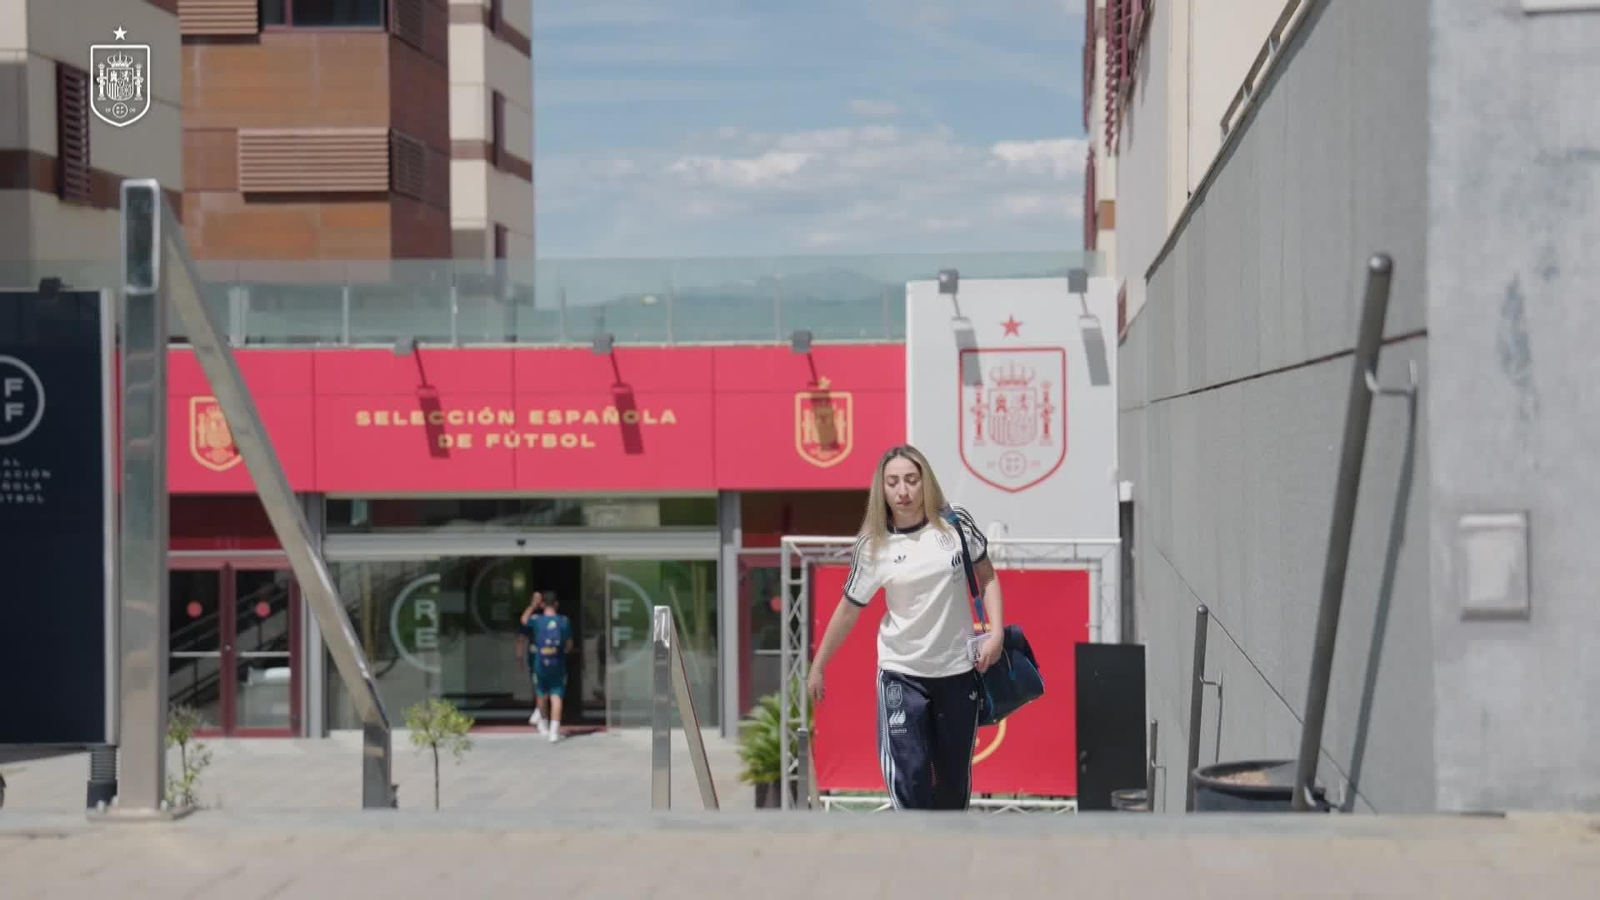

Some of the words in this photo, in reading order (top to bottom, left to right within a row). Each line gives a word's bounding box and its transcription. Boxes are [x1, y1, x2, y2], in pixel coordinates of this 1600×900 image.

[355, 407, 515, 426] SELECCIÓN
[529, 406, 677, 425] ESPAÑOLA
[438, 433, 472, 448] DE
[486, 430, 596, 448] FÚTBOL
